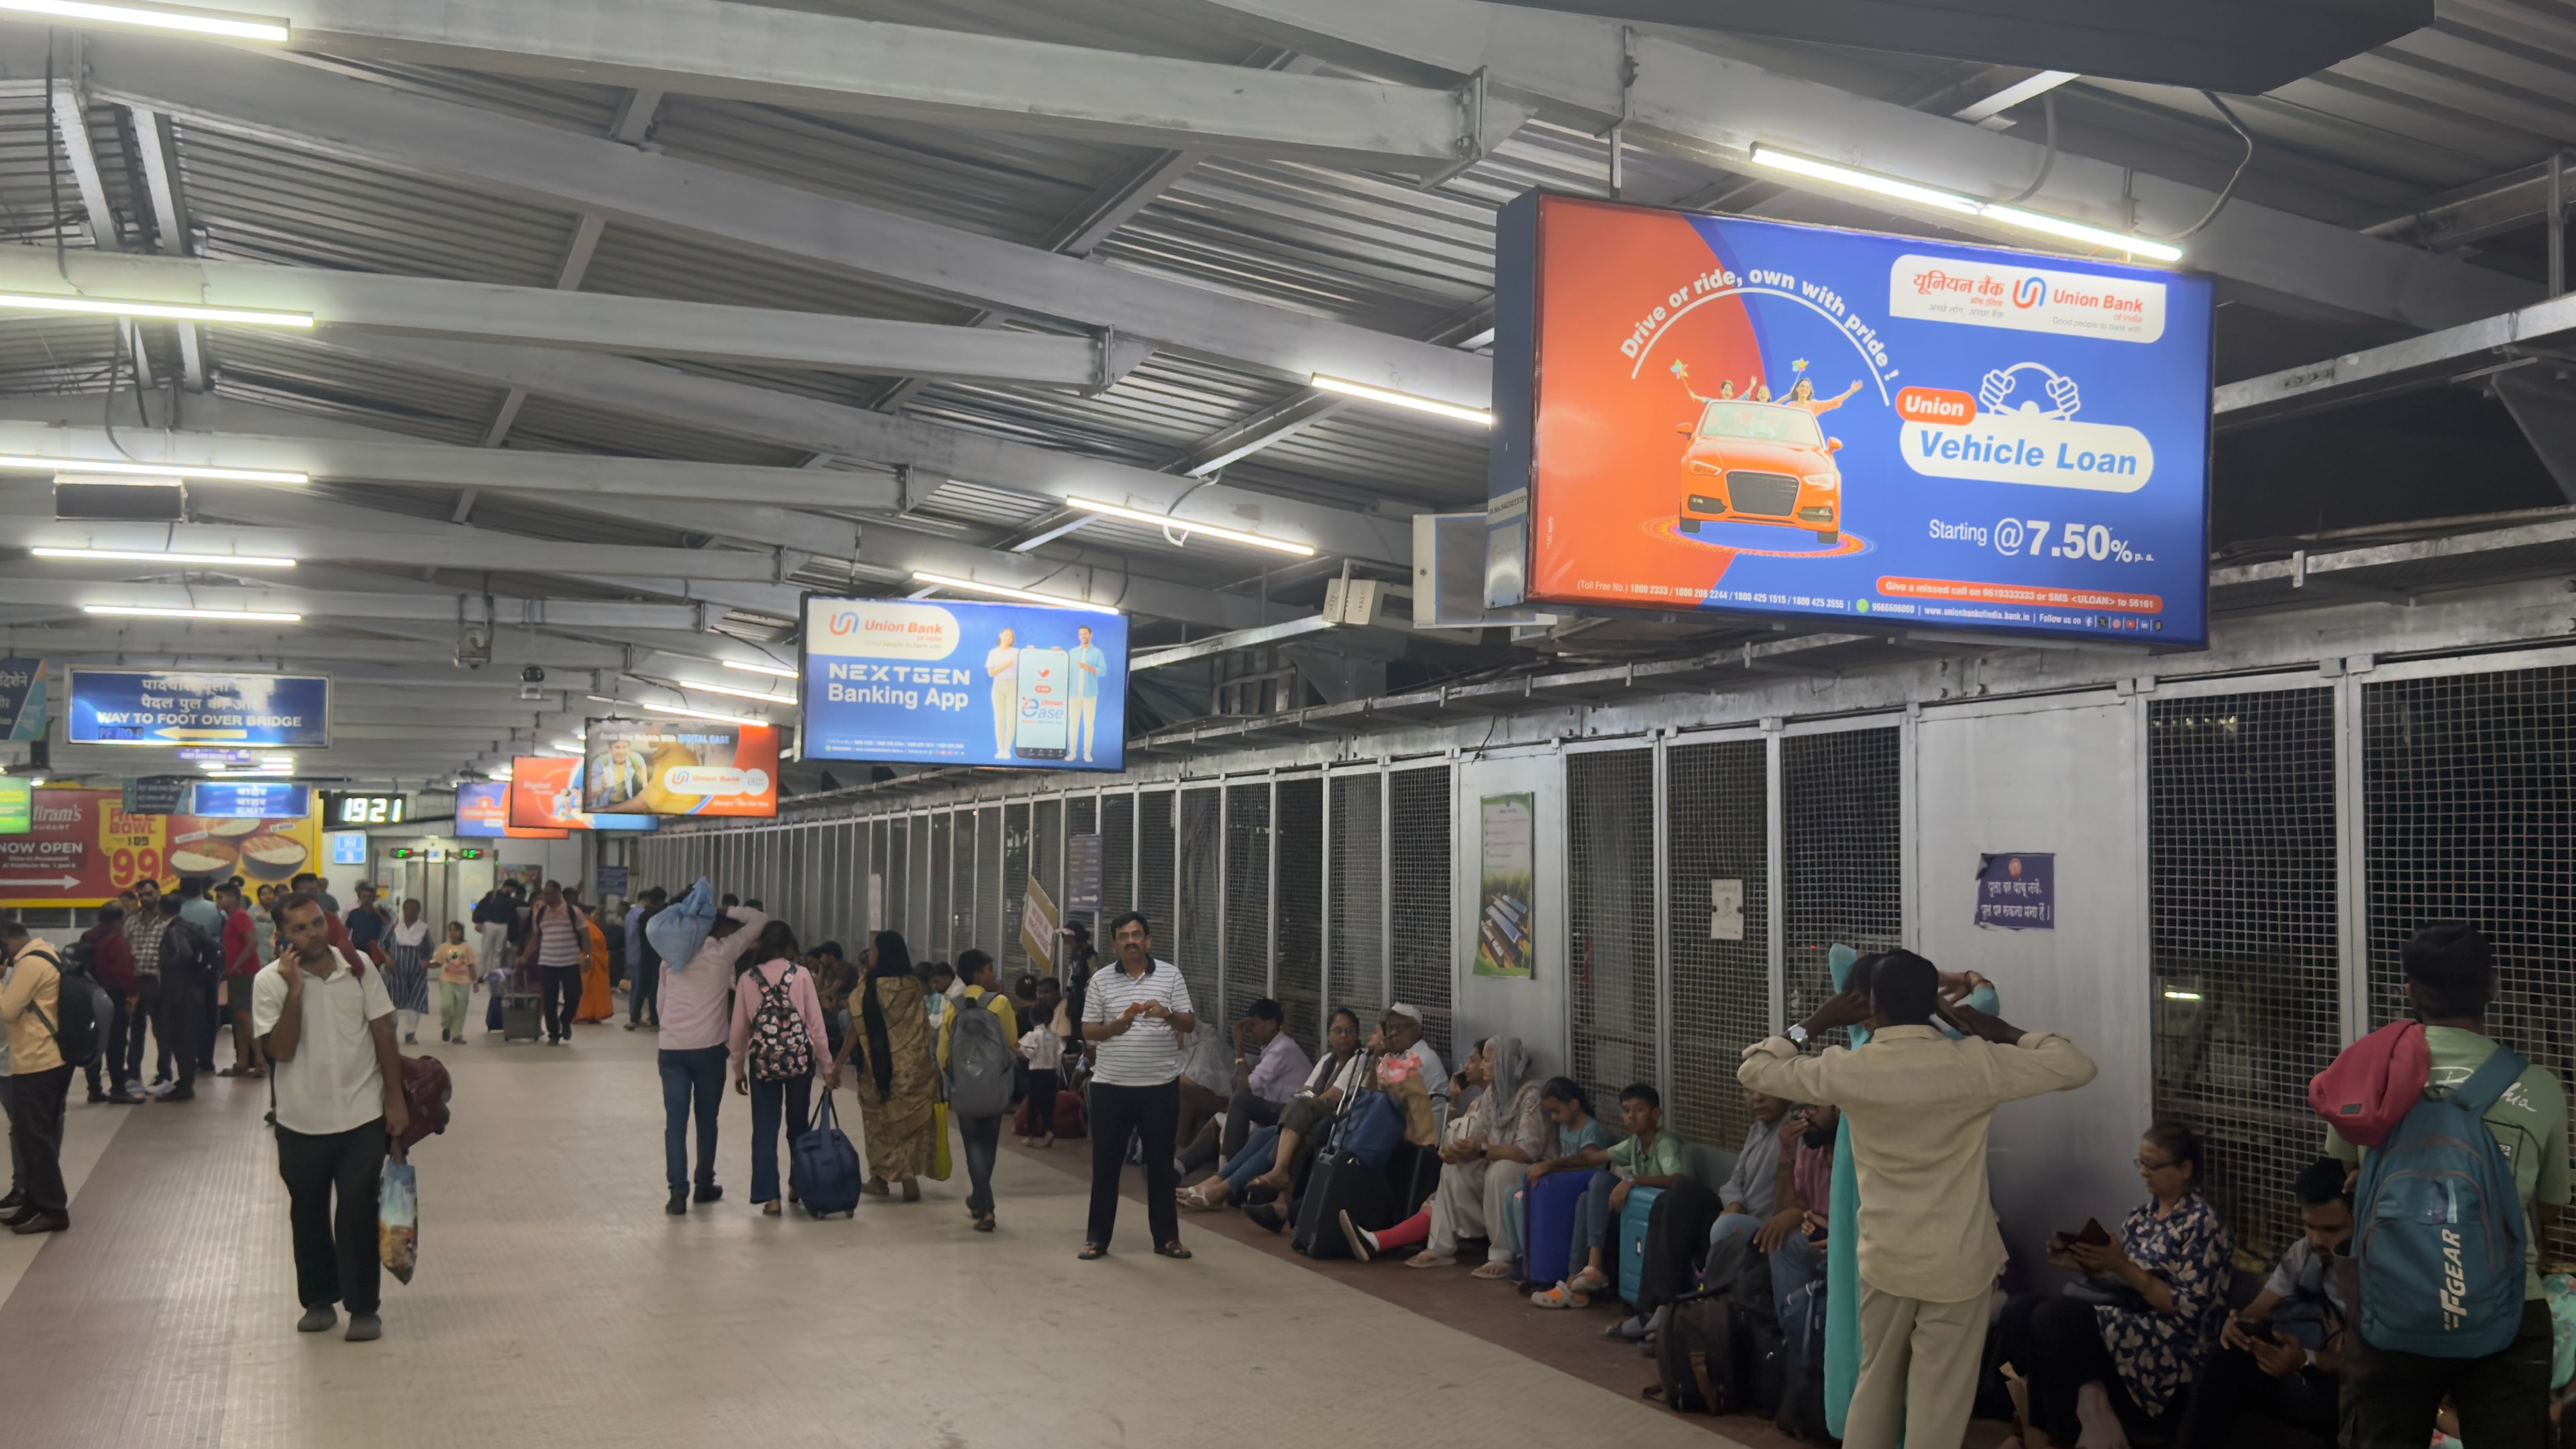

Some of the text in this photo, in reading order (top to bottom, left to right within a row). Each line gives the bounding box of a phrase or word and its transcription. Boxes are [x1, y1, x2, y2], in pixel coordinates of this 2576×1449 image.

[1913, 270, 2005, 296] यूनियन बैंक
[2053, 289, 2143, 313] Union Bank
[1621, 305, 1666, 359] Drive
[1668, 286, 1689, 307] or
[1693, 269, 1743, 295] ride,
[1749, 269, 1794, 289] own
[1801, 280, 1845, 317] with
[1845, 313, 1888, 366] pride
[1970, 308, 1990, 317] अच्छा
[2113, 313, 2143, 323] of India
[2052, 316, 2142, 333] Good people to bank with
[1904, 394, 1965, 417] Union
[1919, 430, 2137, 475] Vehicle Loan
[1929, 519, 1987, 546] Starting
[1577, 580, 1593, 590] (Toll
[1595, 581, 1611, 591] Free
[1613, 582, 1628, 593] No.)
[1630, 584, 1648, 594] 1800
[1650, 585, 1668, 595] 2333
[1675, 587, 1693, 597] 1800
[1694, 588, 1708, 598] 208
[1709, 590, 1727, 600] 2244
[1734, 591, 1752, 602] 1800
[1753, 592, 1767, 602] 425
[1769, 594, 1786, 604] 1515
[1792, 596, 1810, 606] 1800
[1811, 597, 1825, 607] 425
[1826, 598, 1844, 609] 3555
[1886, 581, 1907, 591] Give
[1917, 584, 1949, 594] missed
[1951, 586, 1968, 596] call
[1970, 588, 1980, 596] on
[2037, 592, 2046, 601] or
[2048, 592, 2068, 602] SMS
[2071, 594, 2115, 605] <ULOAN>
[2118, 598, 2127, 606] to
[2129, 598, 2153, 608] 56161
[1924, 606, 2030, 621] www.unionbankofindia.bank.in
[2039, 613, 2061, 624] Follow
[2073, 616, 2081, 625] on
[865, 620, 943, 634] Union Bank
[883, 641, 904, 649] people
[829, 663, 971, 686] NEXTGEN
[142, 694, 173, 709] पैदल
[179, 698, 201, 713] पुल
[828, 683, 969, 712] Banking App
[97, 712, 302, 727] WAY TO FOOT OVER BRIDGE
[678, 734, 709, 744] DIGITAL
[710, 735, 730, 744] EASE
[523, 781, 551, 790] Digital
[109, 823, 157, 835] BOWL
[40, 842, 83, 853] OPEN
[113, 848, 160, 885] 99
